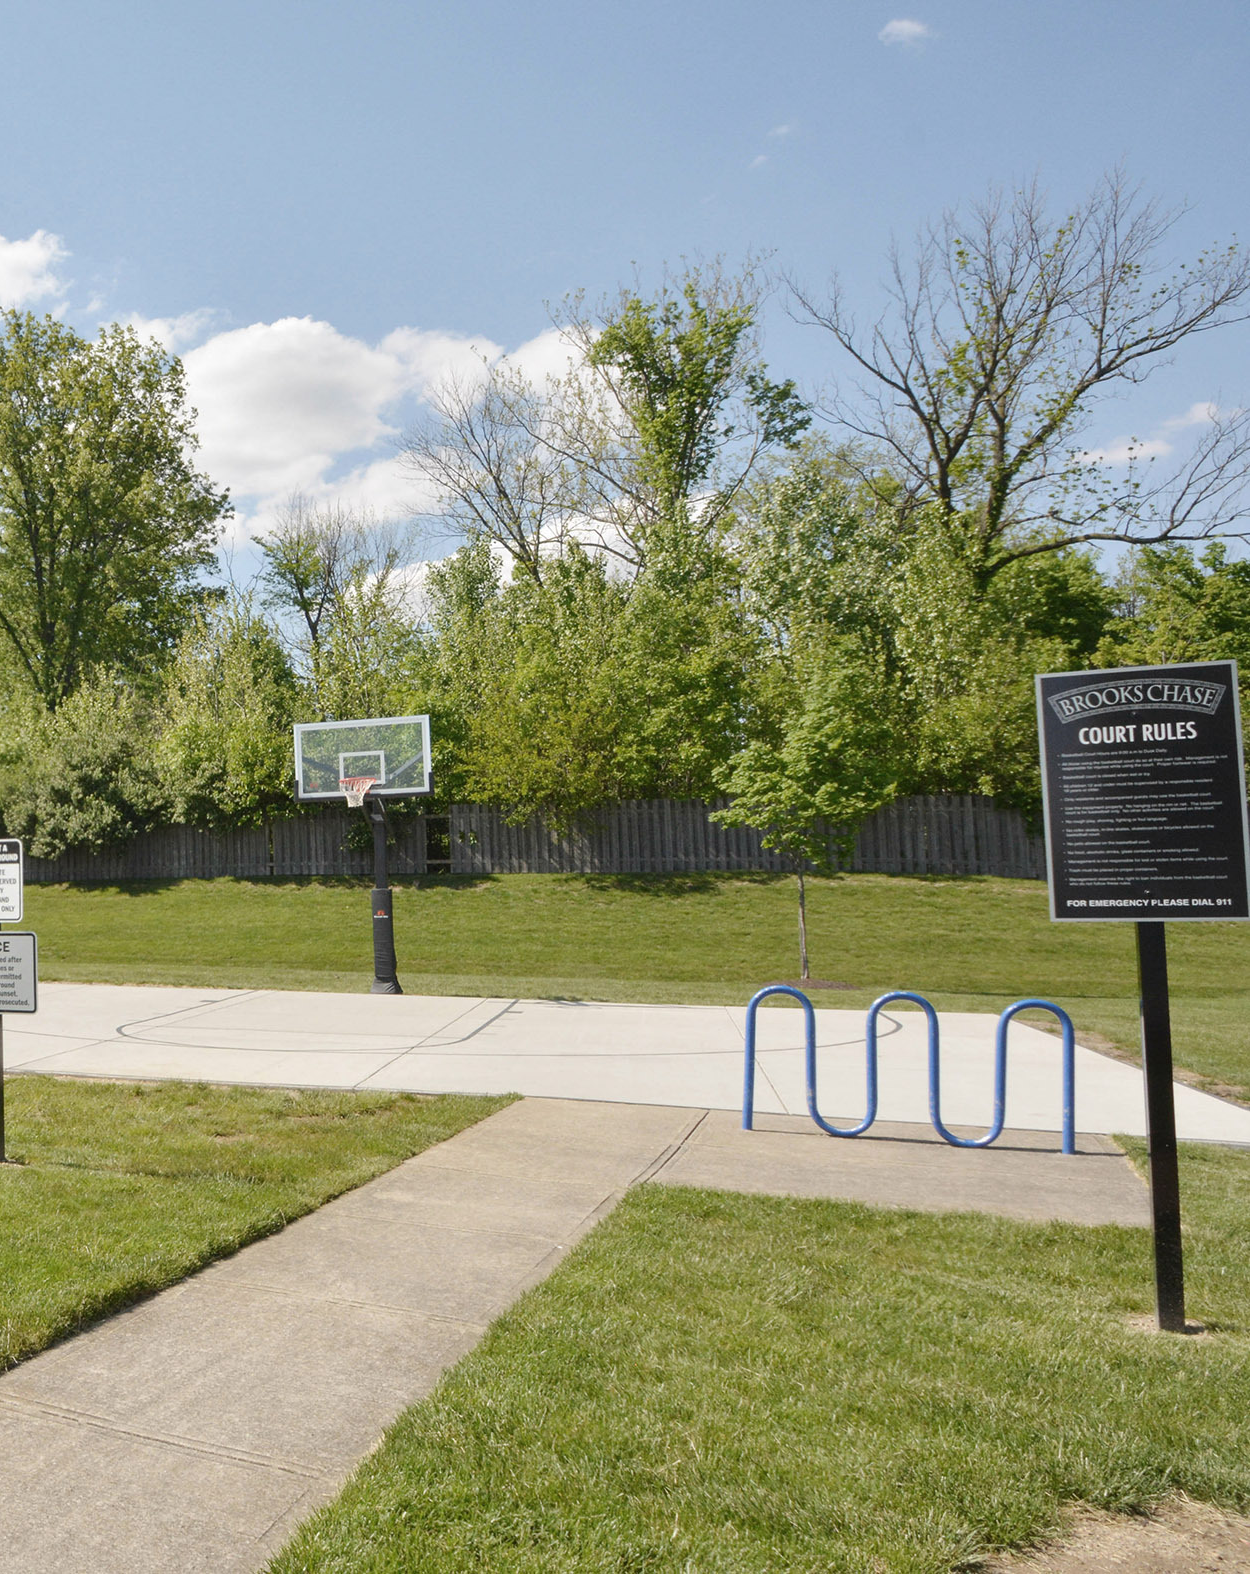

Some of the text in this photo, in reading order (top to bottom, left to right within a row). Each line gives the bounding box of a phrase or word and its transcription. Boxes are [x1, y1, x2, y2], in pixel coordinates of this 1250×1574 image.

[1058, 684, 1216, 716] BROOKS CHASE
[1078, 721, 1198, 745] COURT RULES
[2, 844, 8, 852] A
